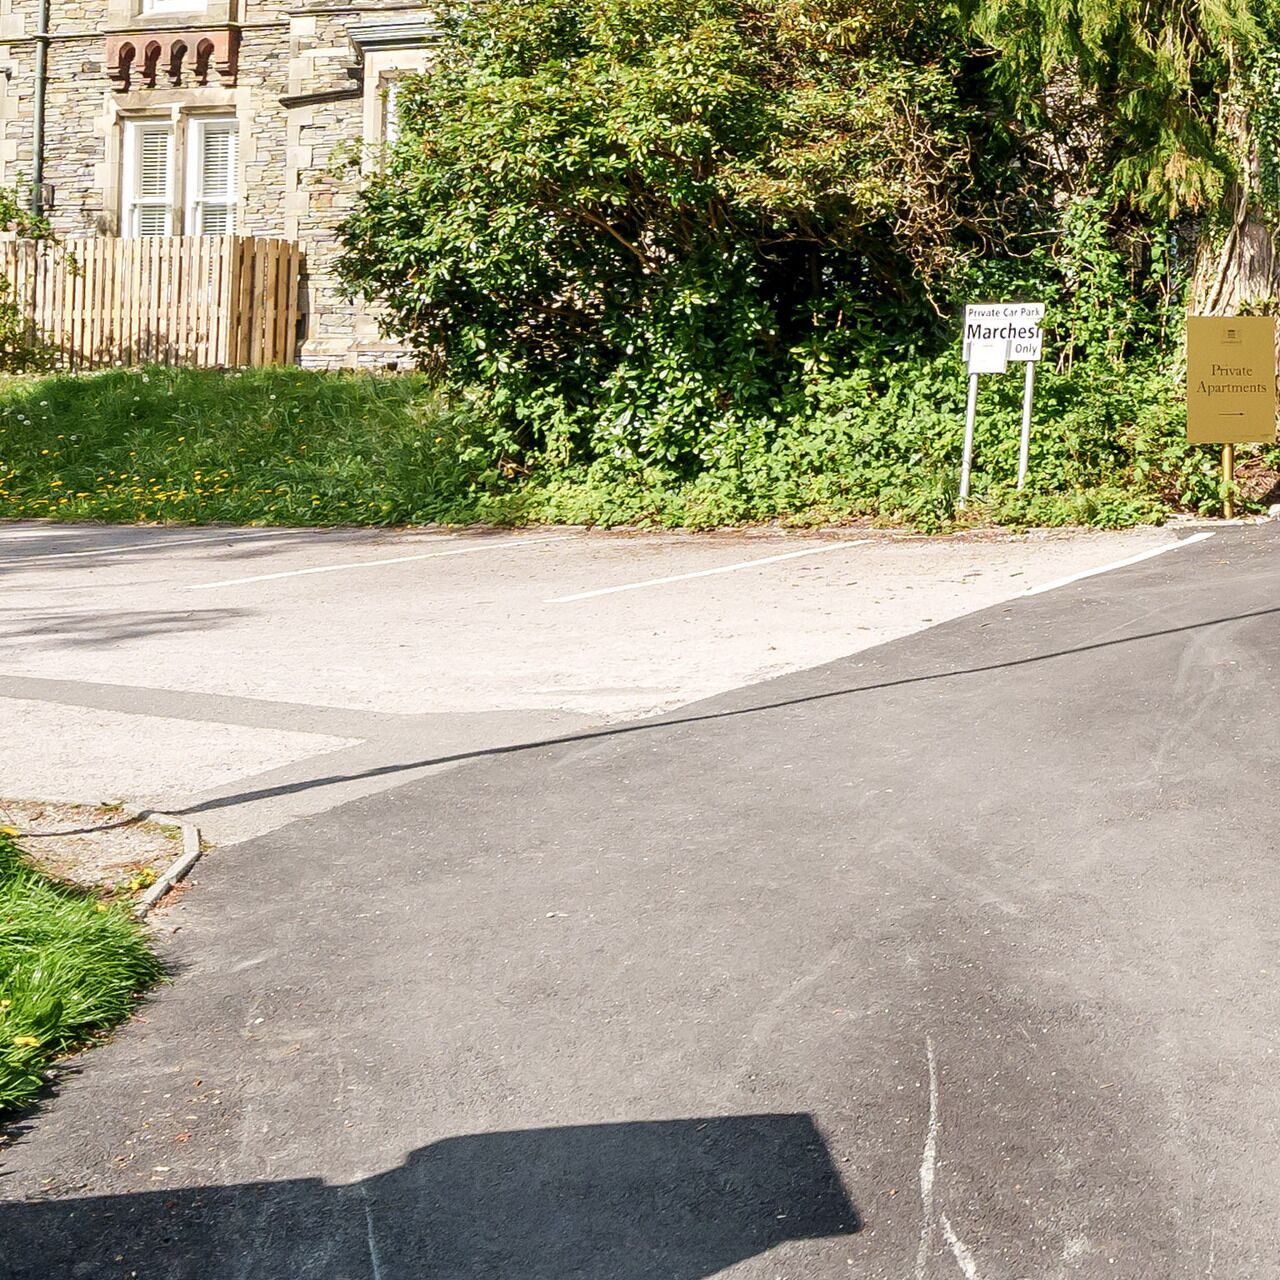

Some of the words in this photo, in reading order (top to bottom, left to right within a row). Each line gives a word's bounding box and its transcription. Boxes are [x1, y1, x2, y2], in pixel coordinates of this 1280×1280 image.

[968, 308, 1000, 317] Private
[1003, 307, 1018, 317] Car
[1020, 307, 1040, 317] Park
[1015, 343, 1038, 356] Only
[1211, 364, 1253, 376] Private
[1197, 380, 1267, 396] Apartments
